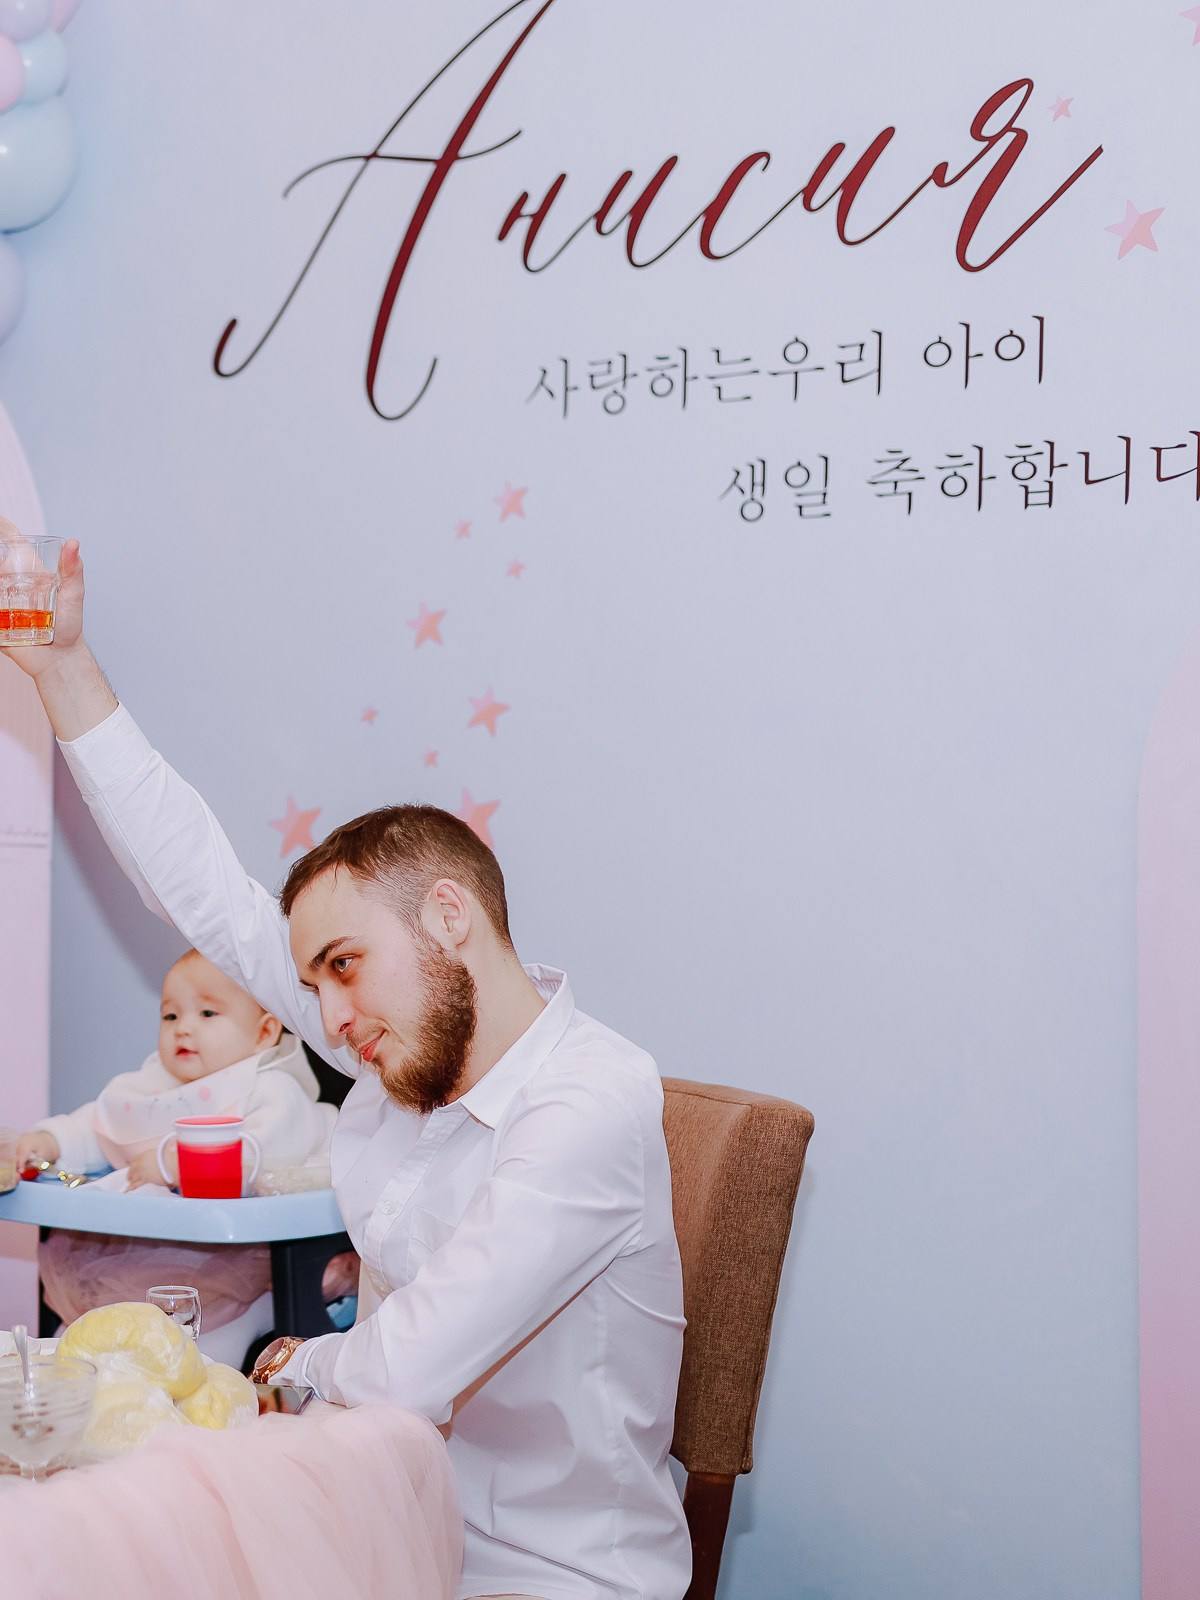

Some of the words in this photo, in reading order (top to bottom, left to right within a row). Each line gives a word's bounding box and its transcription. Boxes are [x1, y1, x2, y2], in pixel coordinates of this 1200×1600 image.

[211, 0, 1106, 422] Анисия
[922, 315, 1046, 392] 아이
[718, 454, 833, 524] 생일
[865, 430, 1200, 518] 축하합니다
